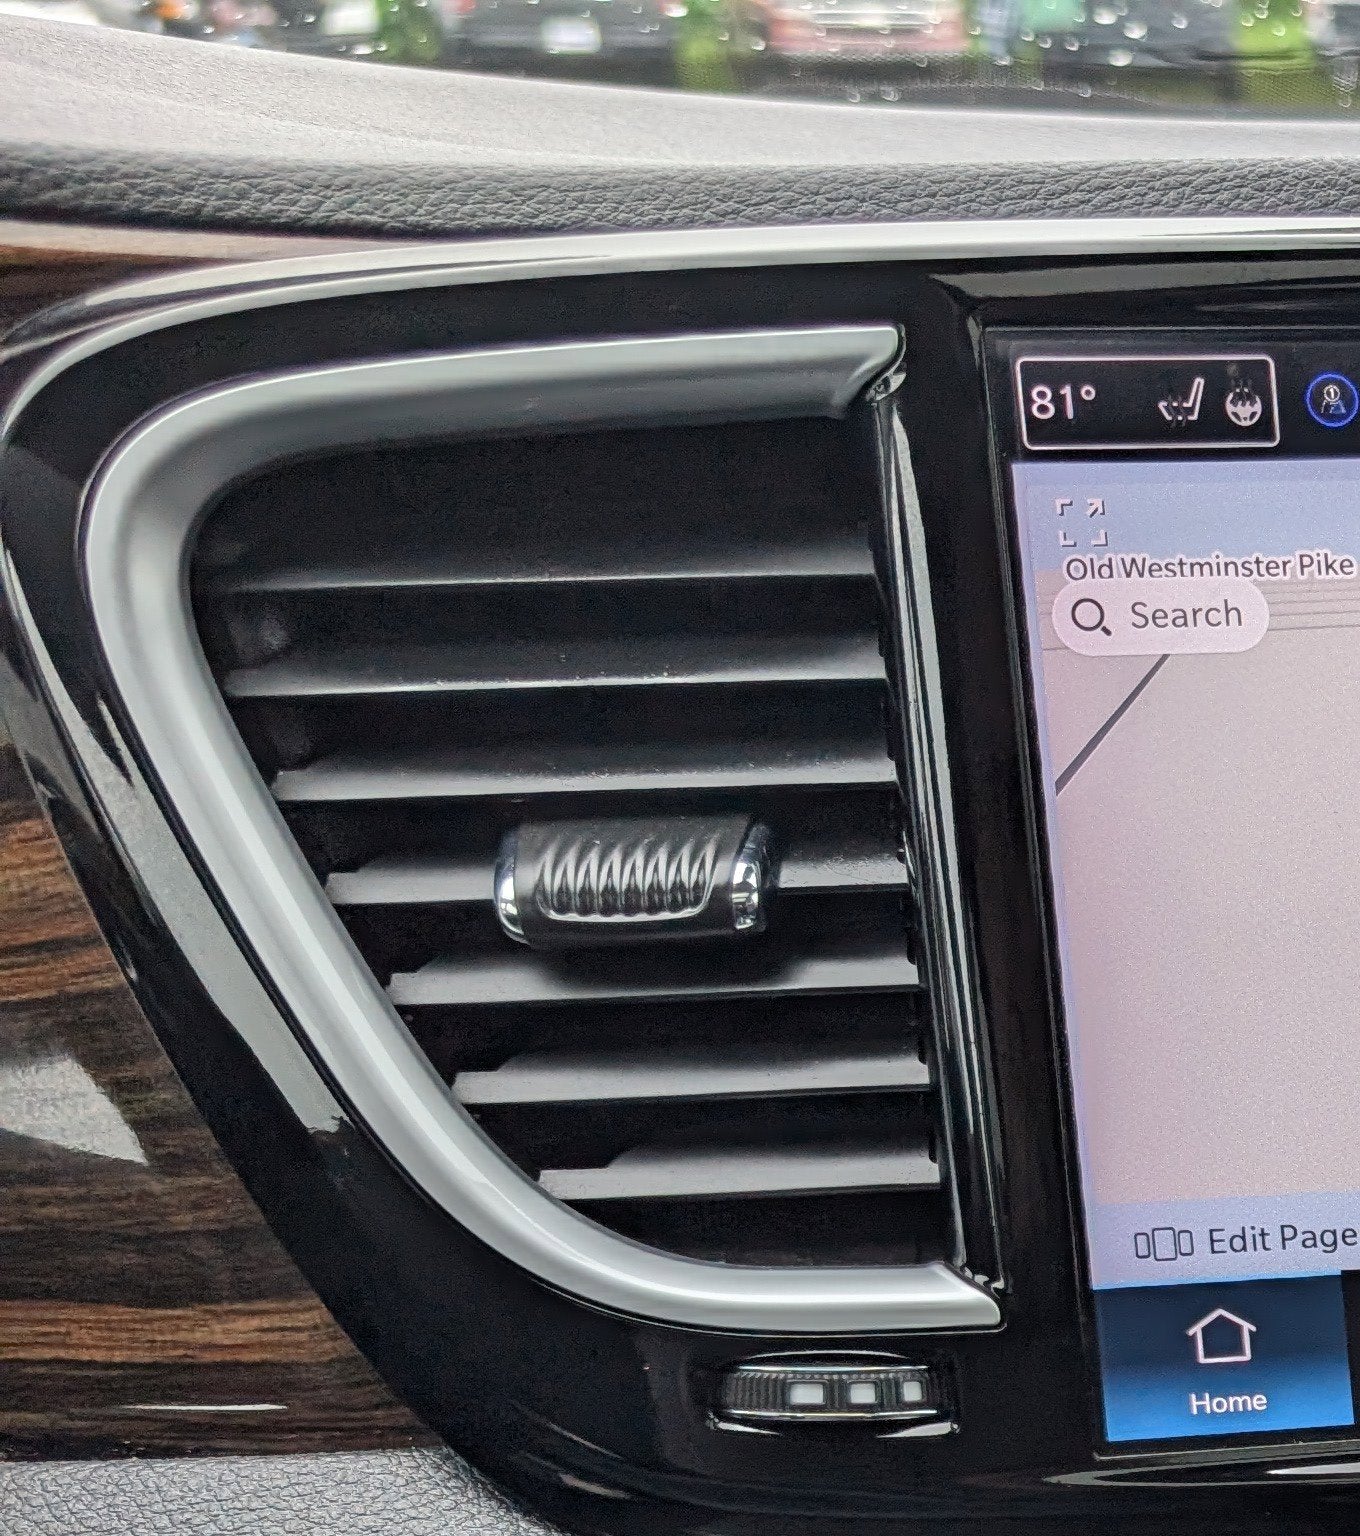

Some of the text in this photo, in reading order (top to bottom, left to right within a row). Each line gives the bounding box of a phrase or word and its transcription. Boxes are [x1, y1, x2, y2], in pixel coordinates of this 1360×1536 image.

[1029, 383, 1097, 420] 81°
[1064, 553, 1356, 581] Old Westminster Pike
[1130, 599, 1243, 629] Search
[1208, 1226, 1271, 1254] Edit
[1190, 1390, 1268, 1414] Home
